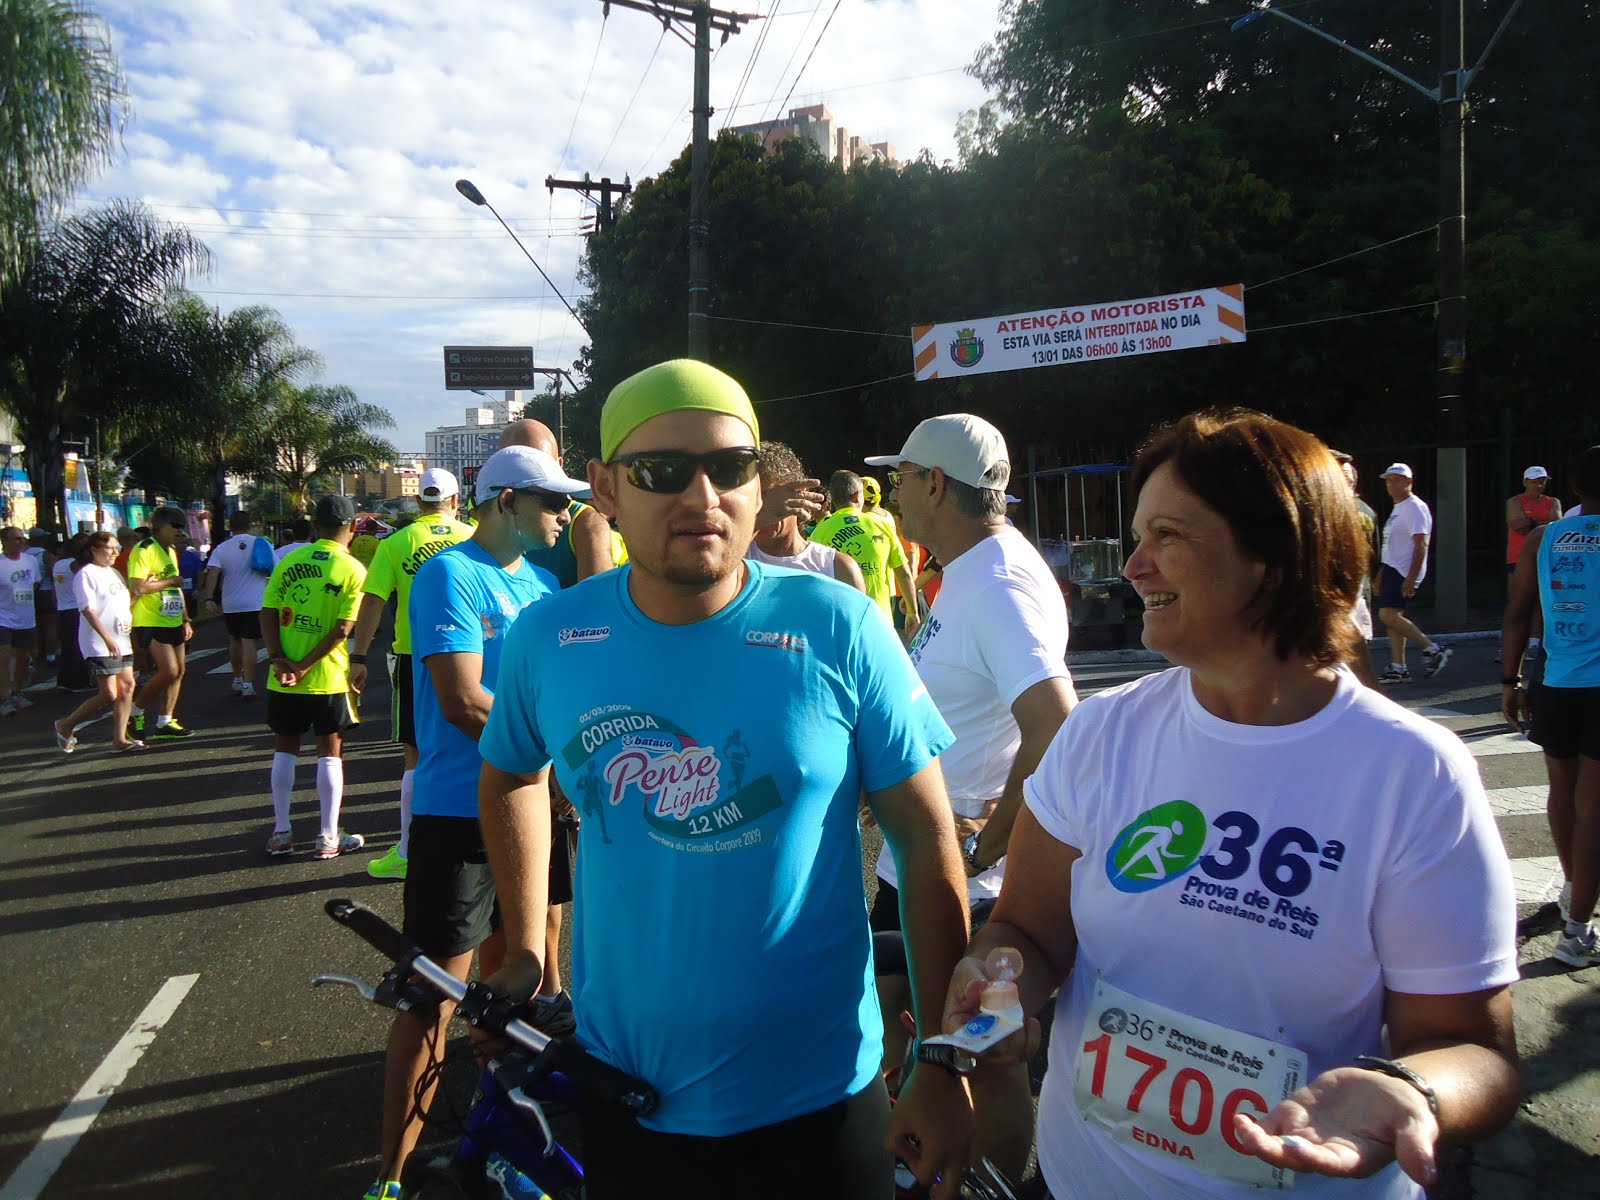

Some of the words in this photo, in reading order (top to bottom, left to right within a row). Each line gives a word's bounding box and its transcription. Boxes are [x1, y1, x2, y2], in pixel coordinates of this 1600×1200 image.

[997, 310, 1085, 334] ATENÇÃO
[1091, 295, 1206, 321] MOTORISTA
[1003, 335, 1030, 350] ESTA
[1032, 333, 1051, 346] VIA
[1054, 326, 1082, 343] SERÁ
[1085, 319, 1158, 340] INTERDITADA
[1161, 316, 1178, 330] NO
[1181, 314, 1201, 328] DIA
[1032, 348, 1058, 364] 13/01
[1062, 346, 1083, 361] DAS
[1086, 342, 1118, 358] 06h00
[1121, 338, 1136, 353] ÀS
[1139, 335, 1172, 350] 13h00
[294, 614, 322, 628] FELL
[571, 627, 610, 638] batavo
[581, 715, 660, 753] CORRIDA
[634, 736, 673, 748] batavo
[607, 752, 718, 803] Pense
[659, 777, 718, 816] Light
[688, 815, 713, 835] 12
[712, 801, 743, 828] KM
[742, 828, 762, 846] 2009
[1200, 810, 1346, 897] 36ª
[1179, 893, 1205, 908] São
[1208, 899, 1266, 924] Caetano
[1268, 917, 1287, 931] do
[1290, 922, 1315, 940] Sul
[1184, 875, 1239, 901] Prova
[1243, 889, 1270, 910] de
[1273, 897, 1320, 927] Reis
[1165, 1039, 1183, 1053] São
[1185, 1046, 1226, 1068] Caetano
[1228, 1060, 1240, 1073] do
[1242, 1067, 1260, 1080] Sul
[1169, 1028, 1208, 1052] Prova
[1210, 1044, 1229, 1059] de
[1231, 1050, 1264, 1071] Reis
[1132, 1124, 1196, 1161] EDNA
